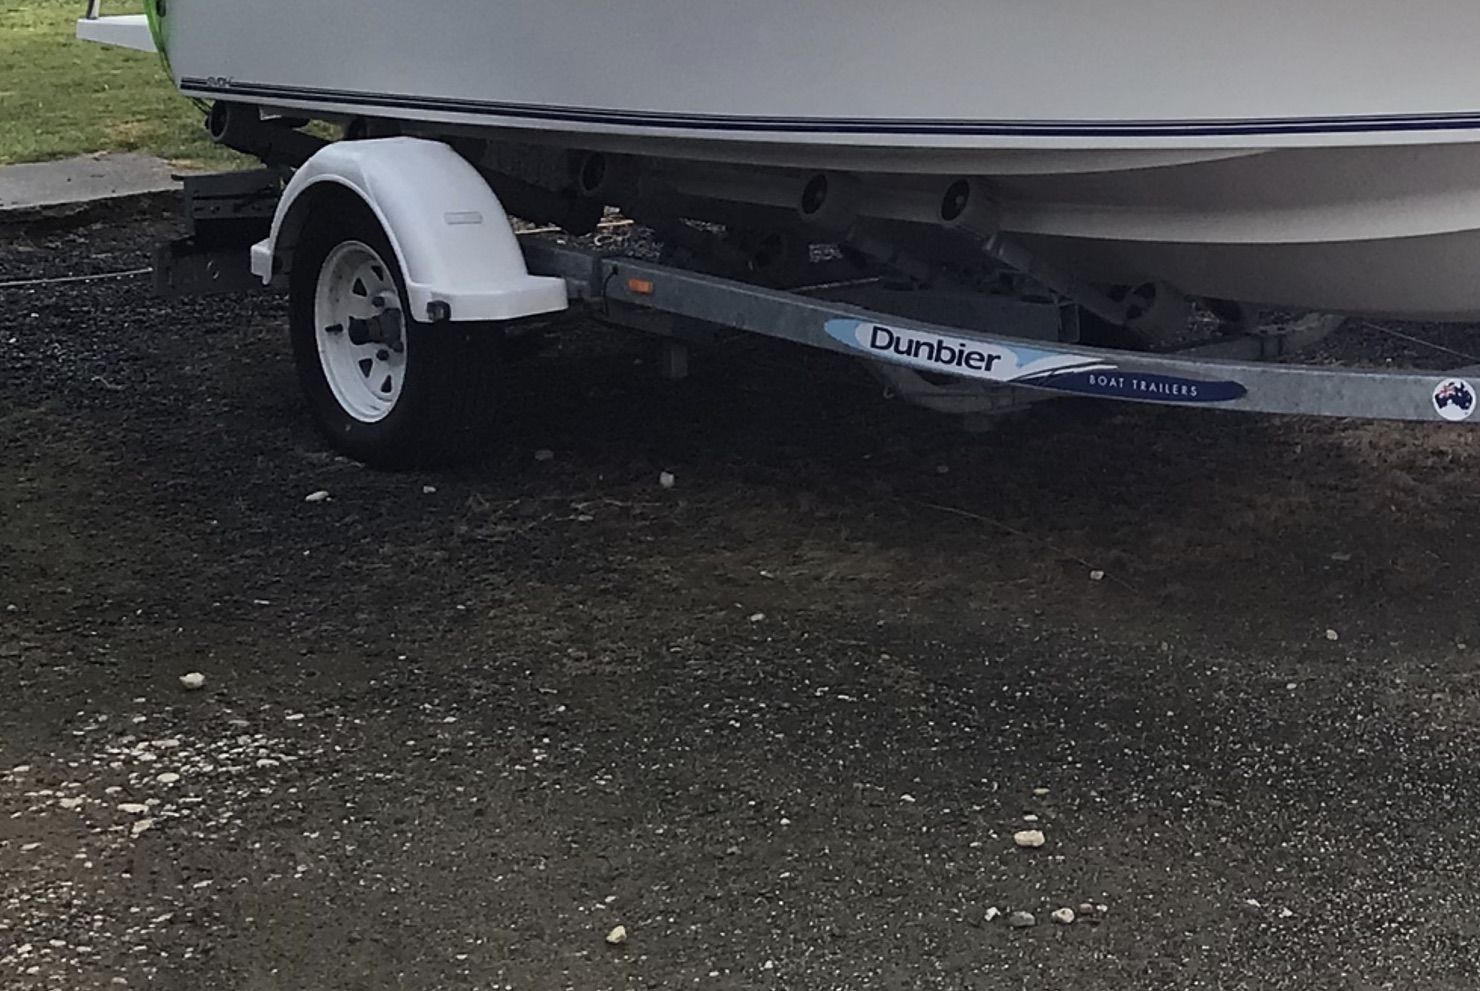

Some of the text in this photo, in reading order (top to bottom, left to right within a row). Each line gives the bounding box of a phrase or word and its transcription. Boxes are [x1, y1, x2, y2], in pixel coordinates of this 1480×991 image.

[869, 325, 1001, 372] Dunbier
[1089, 374, 1198, 397] BOAT TRAILERS
